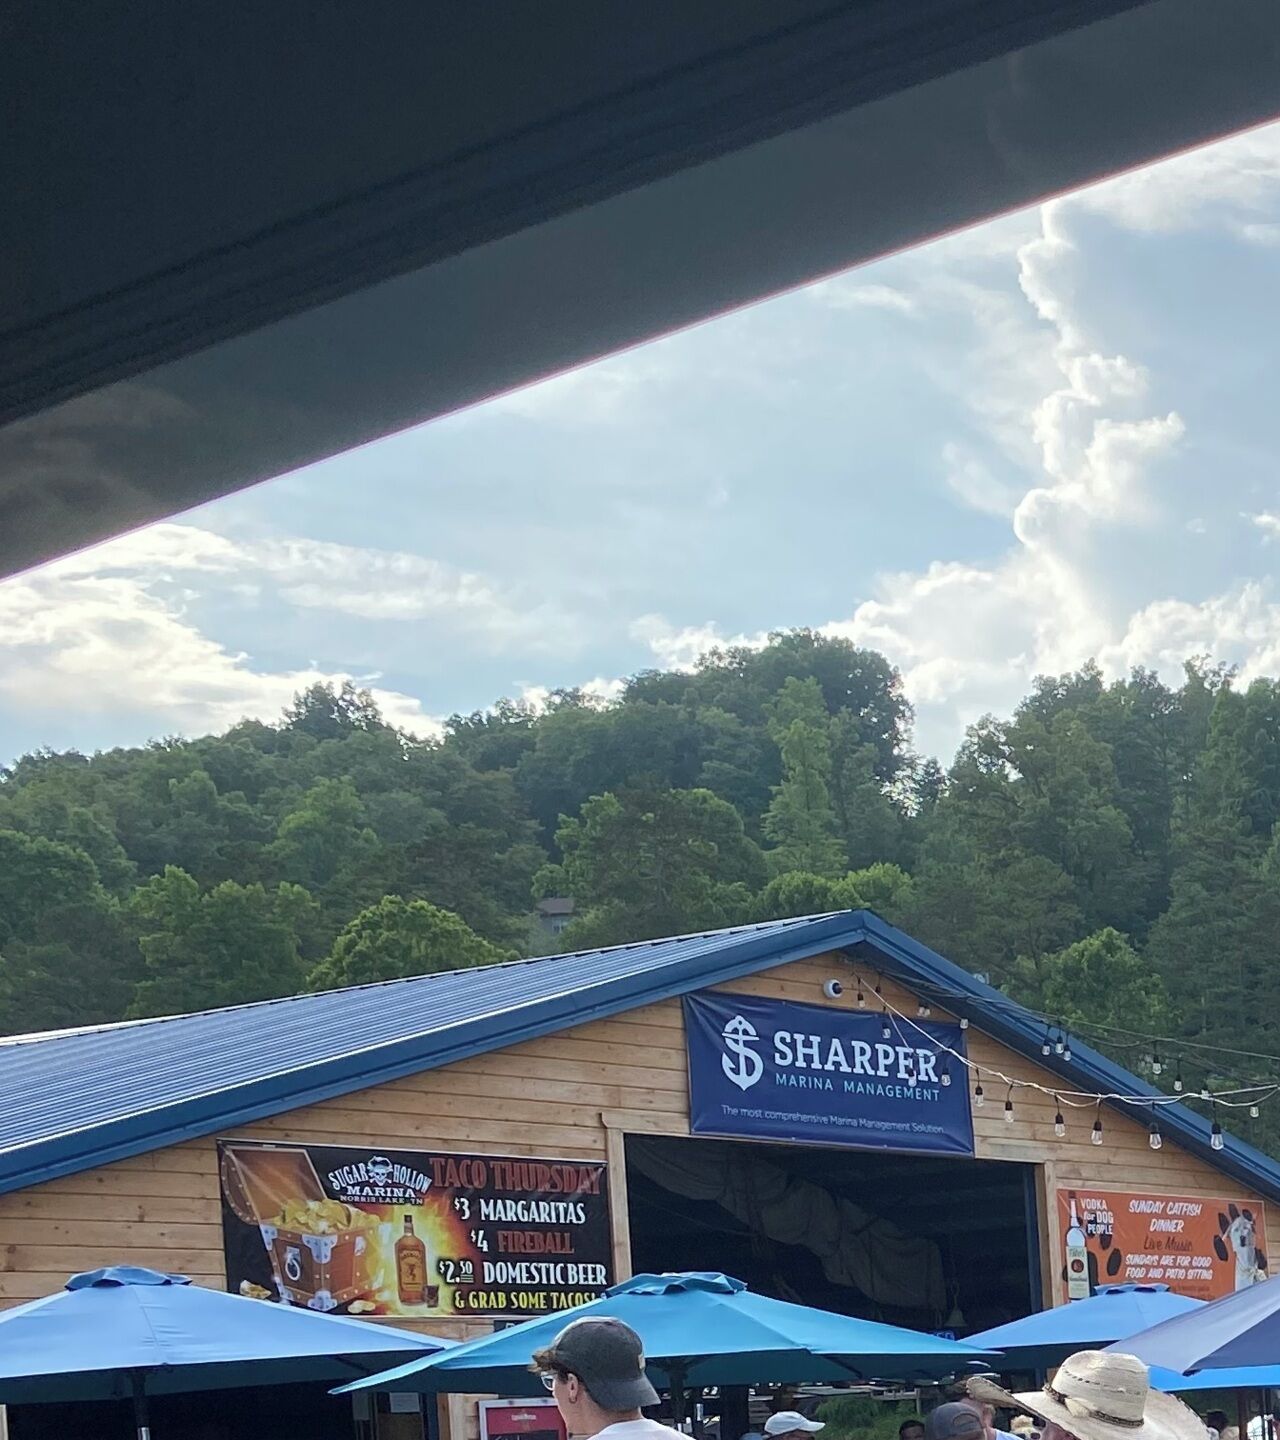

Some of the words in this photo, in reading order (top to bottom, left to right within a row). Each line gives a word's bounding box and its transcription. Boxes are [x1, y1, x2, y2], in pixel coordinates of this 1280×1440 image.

[774, 1031, 938, 1083] SHARPER
[776, 1073, 833, 1091] MARINA
[844, 1079, 940, 1101] MANAGEMENT
[721, 1105, 738, 1116] The
[740, 1109, 763, 1118] most
[764, 1111, 828, 1126] comprehensive
[829, 1115, 857, 1127] Marina
[859, 1118, 910, 1132] Management
[328, 1162, 369, 1190] SUGAR
[393, 1164, 432, 1194] HOLLOW
[429, 1158, 487, 1189] TACO
[490, 1161, 603, 1194] THURSDAY
[340, 1195, 376, 1203] NORRIS
[379, 1196, 405, 1204] LAKE
[346, 1186, 416, 1198] MARINA
[454, 1198, 470, 1220] $3
[480, 1198, 586, 1224] MARGARITAS
[1080, 1198, 1107, 1210] VODKA
[1129, 1200, 1165, 1214] SUNDAY
[1167, 1201, 1202, 1216] CATFISH
[1083, 1211, 1095, 1221] for
[1096, 1211, 1114, 1224] DOG
[1149, 1219, 1184, 1233] DINNER
[1088, 1223, 1113, 1234] PEOPLE
[470, 1230, 488, 1252] $4
[497, 1230, 574, 1254] FIREBALL
[1125, 1254, 1158, 1266] SUNDAYS
[1160, 1255, 1175, 1266] ARE
[1176, 1256, 1191, 1267] FOR
[1192, 1256, 1212, 1267] GOOD
[483, 1261, 568, 1284] DOMESTIC
[569, 1263, 607, 1285] BEER
[1125, 1267, 1146, 1278] FOOD
[1148, 1267, 1163, 1278] AND
[1165, 1268, 1186, 1279] PATIO
[455, 1291, 464, 1308] &
[469, 1291, 506, 1308] GRAB
[511, 1292, 547, 1309] SOME
